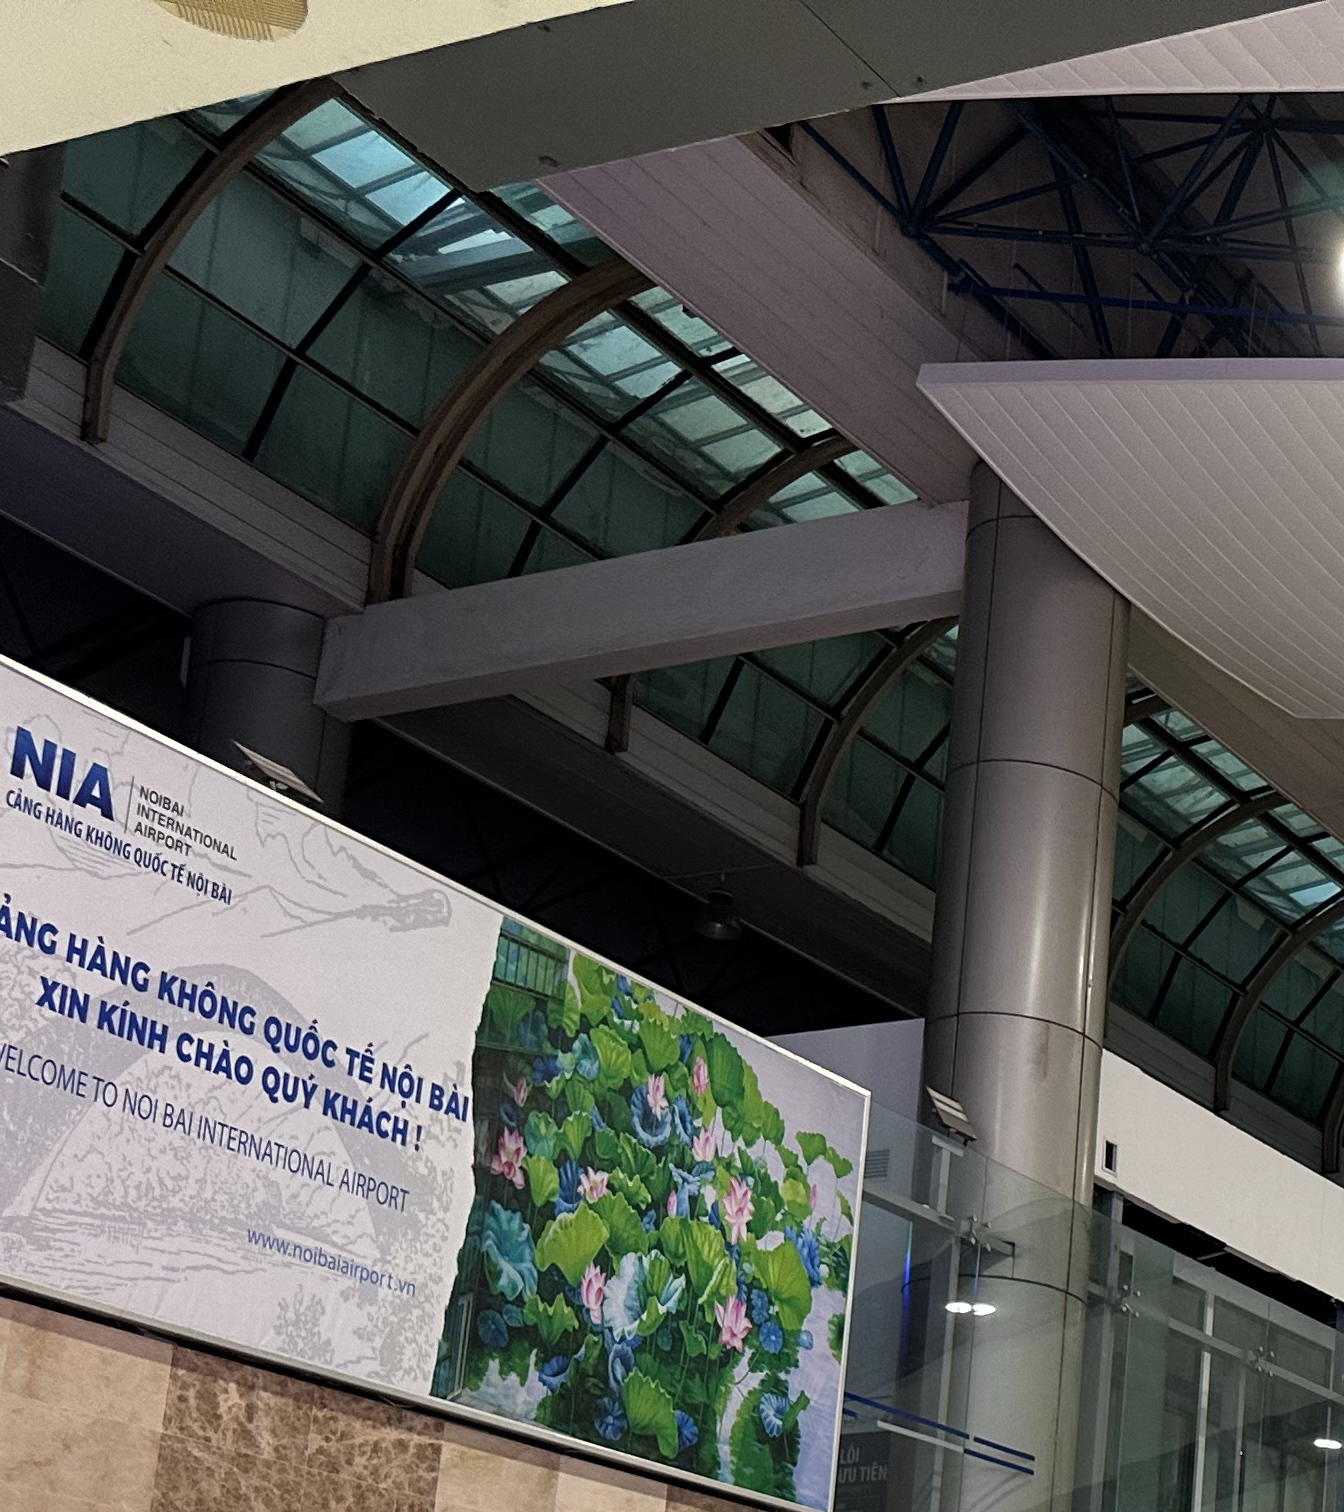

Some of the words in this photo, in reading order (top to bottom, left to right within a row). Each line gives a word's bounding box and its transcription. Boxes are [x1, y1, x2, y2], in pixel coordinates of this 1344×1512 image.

[10, 726, 114, 821] NIA
[140, 785, 185, 817] NOIBAI
[6, 788, 43, 820] CẢNG
[45, 808, 83, 838] HÀNG
[85, 825, 131, 860] KHÔNG
[133, 848, 169, 877] QUỐC
[170, 861, 186, 884] TẾ
[186, 871, 209, 897] NỘI
[210, 880, 232, 905] BÀI
[134, 821, 192, 857] AIRPORT
[136, 803, 238, 861] INTERNATIONAL
[0, 893, 59, 955] ẢNG
[66, 936, 151, 992] HÀNG
[158, 971, 257, 1036] KHÔNG
[263, 1019, 338, 1068] QUỐC
[345, 1042, 375, 1085] TẾ
[380, 1063, 424, 1109] NỘI
[429, 1083, 469, 1123] BÀI
[36, 975, 90, 1024] XIN
[96, 1000, 169, 1054] KÍNH
[176, 1032, 254, 1085] CHÀO
[262, 1066, 319, 1110] QUÝ
[322, 1088, 409, 1147] KHÁCH
[92, 1075, 118, 1108] TO
[122, 1088, 158, 1124] NOI
[162, 1103, 193, 1137] BAI
[197, 1114, 334, 1188] INTERNATIONAL
[339, 1167, 410, 1213] AIRPORT
[247, 1228, 416, 1298] www.noibaiairport.vn
[860, 1461, 887, 1482] TIÊN
